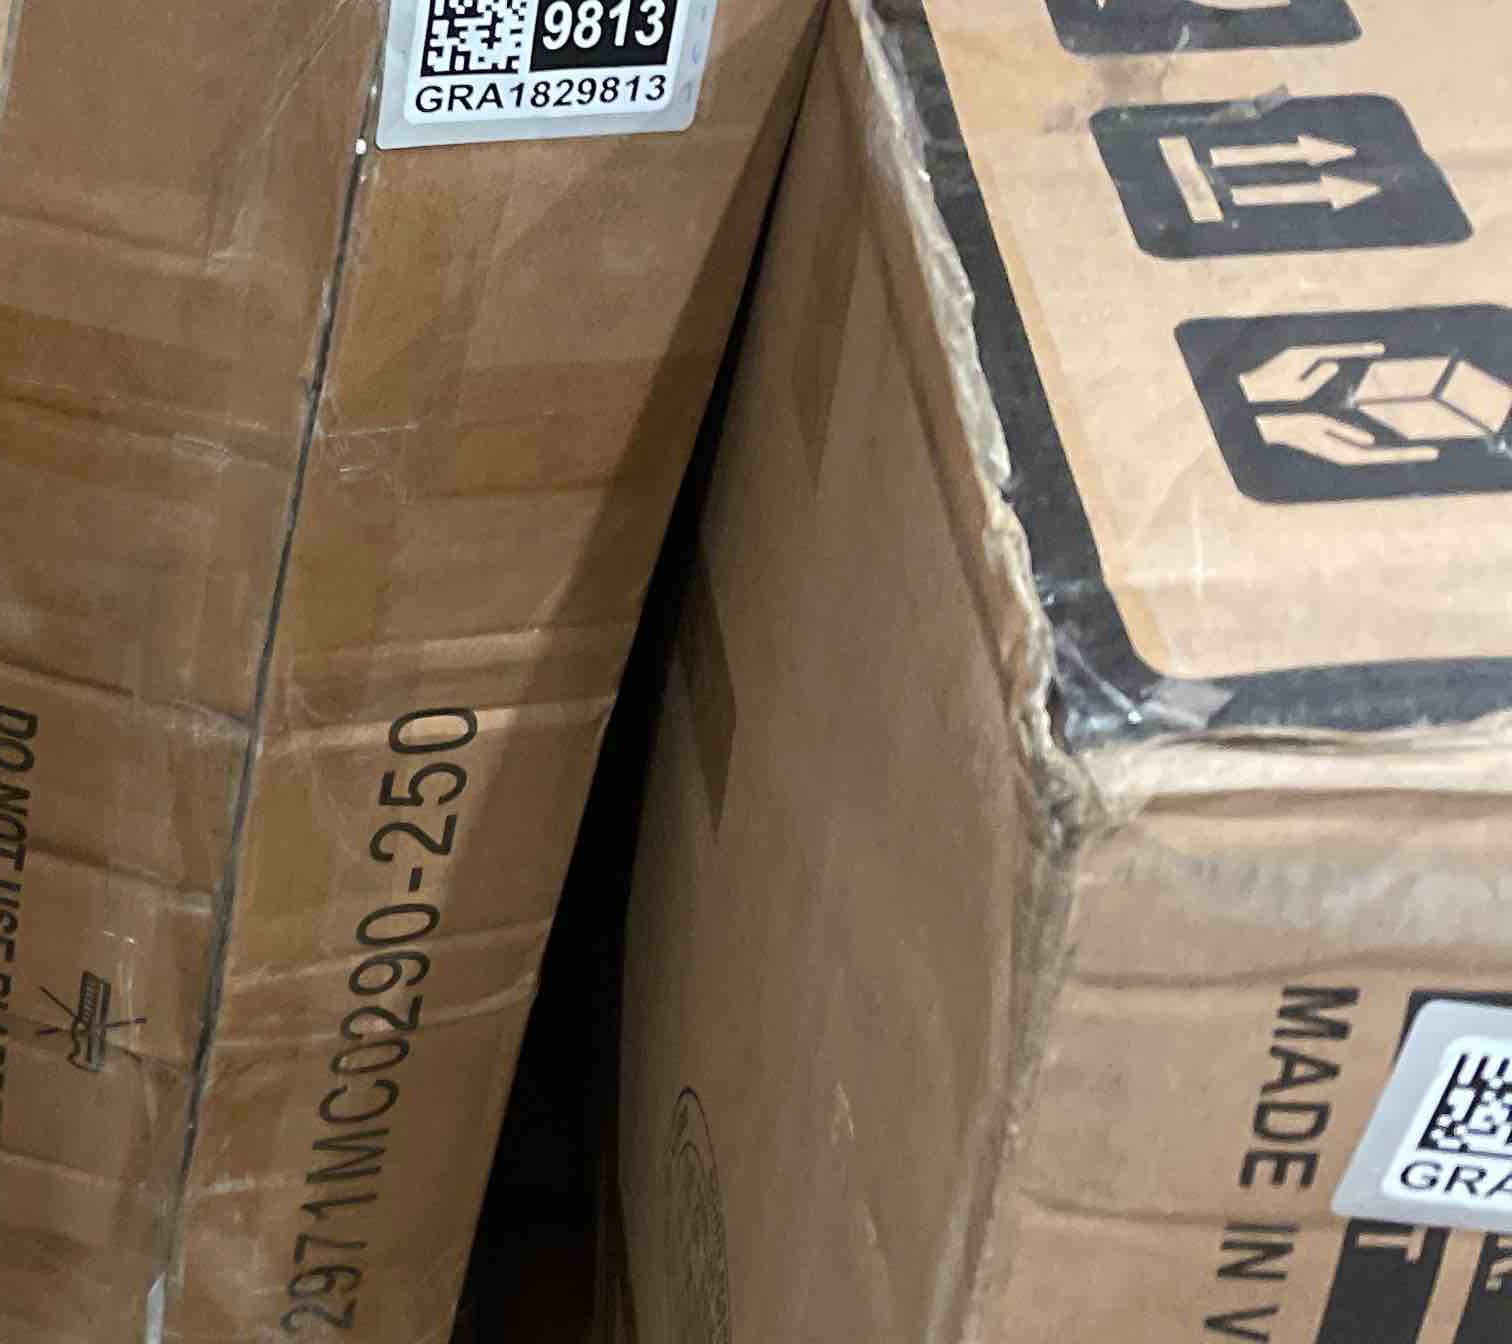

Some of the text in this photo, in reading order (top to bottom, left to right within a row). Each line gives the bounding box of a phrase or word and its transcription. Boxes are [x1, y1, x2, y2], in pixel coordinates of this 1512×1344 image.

[415, 74, 667, 113] GRA1829813
[279, 707, 478, 1333] 2971MC0290-250
[1238, 985, 1361, 1191] MADE
[1215, 1221, 1300, 1282] IN
